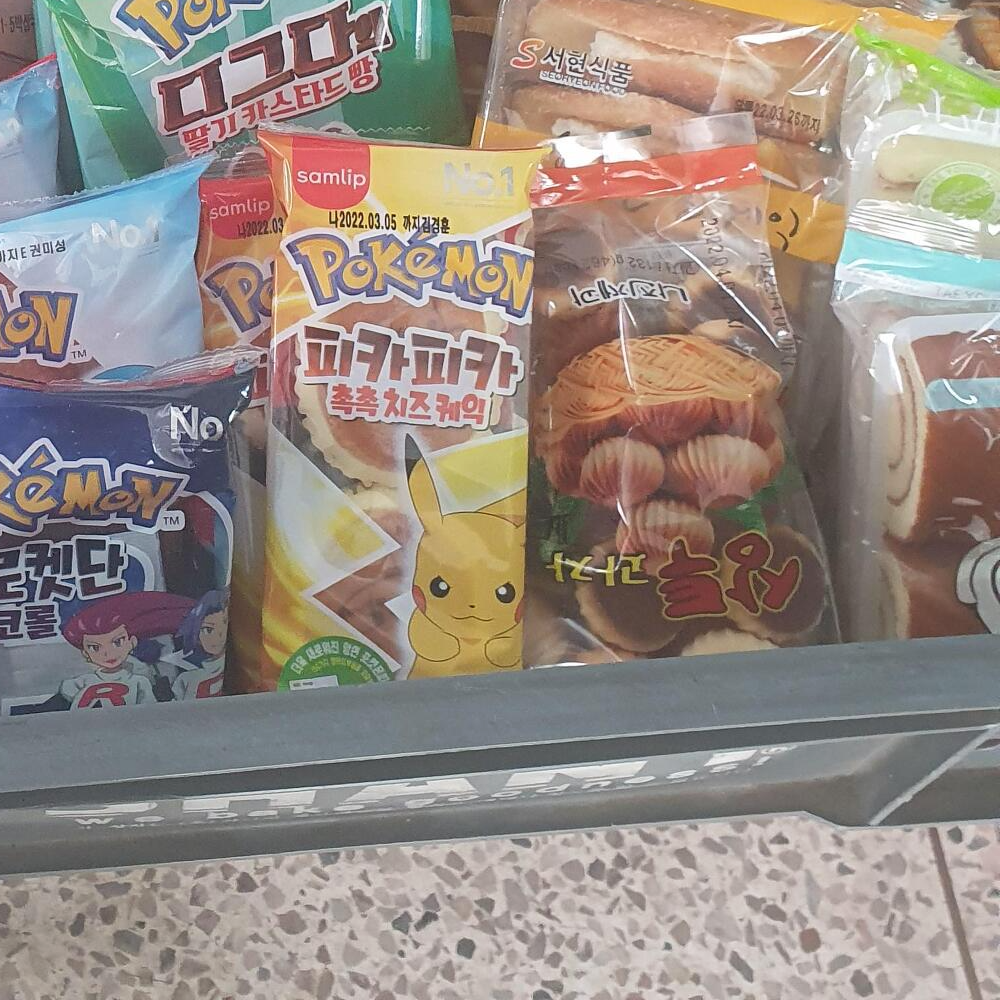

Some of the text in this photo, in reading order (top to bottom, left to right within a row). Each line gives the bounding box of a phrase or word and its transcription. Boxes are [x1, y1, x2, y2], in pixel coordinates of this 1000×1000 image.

[543, 46, 634, 87] 서현식품
[297, 168, 367, 188] samlip
[443, 163, 515, 196] No.1
[209, 198, 271, 220] samlip
[328, 210, 397, 230] 나2022.03.05
[238, 217, 284, 238] 나2022.03
[28, 240, 67, 261] 권미성
[304, 326, 519, 390] 피카피카
[330, 385, 379, 415] 촉촉
[384, 389, 431, 420] 치즈
[170, 405, 224, 440] No
[547, 529, 802, 619] 상투 과자
